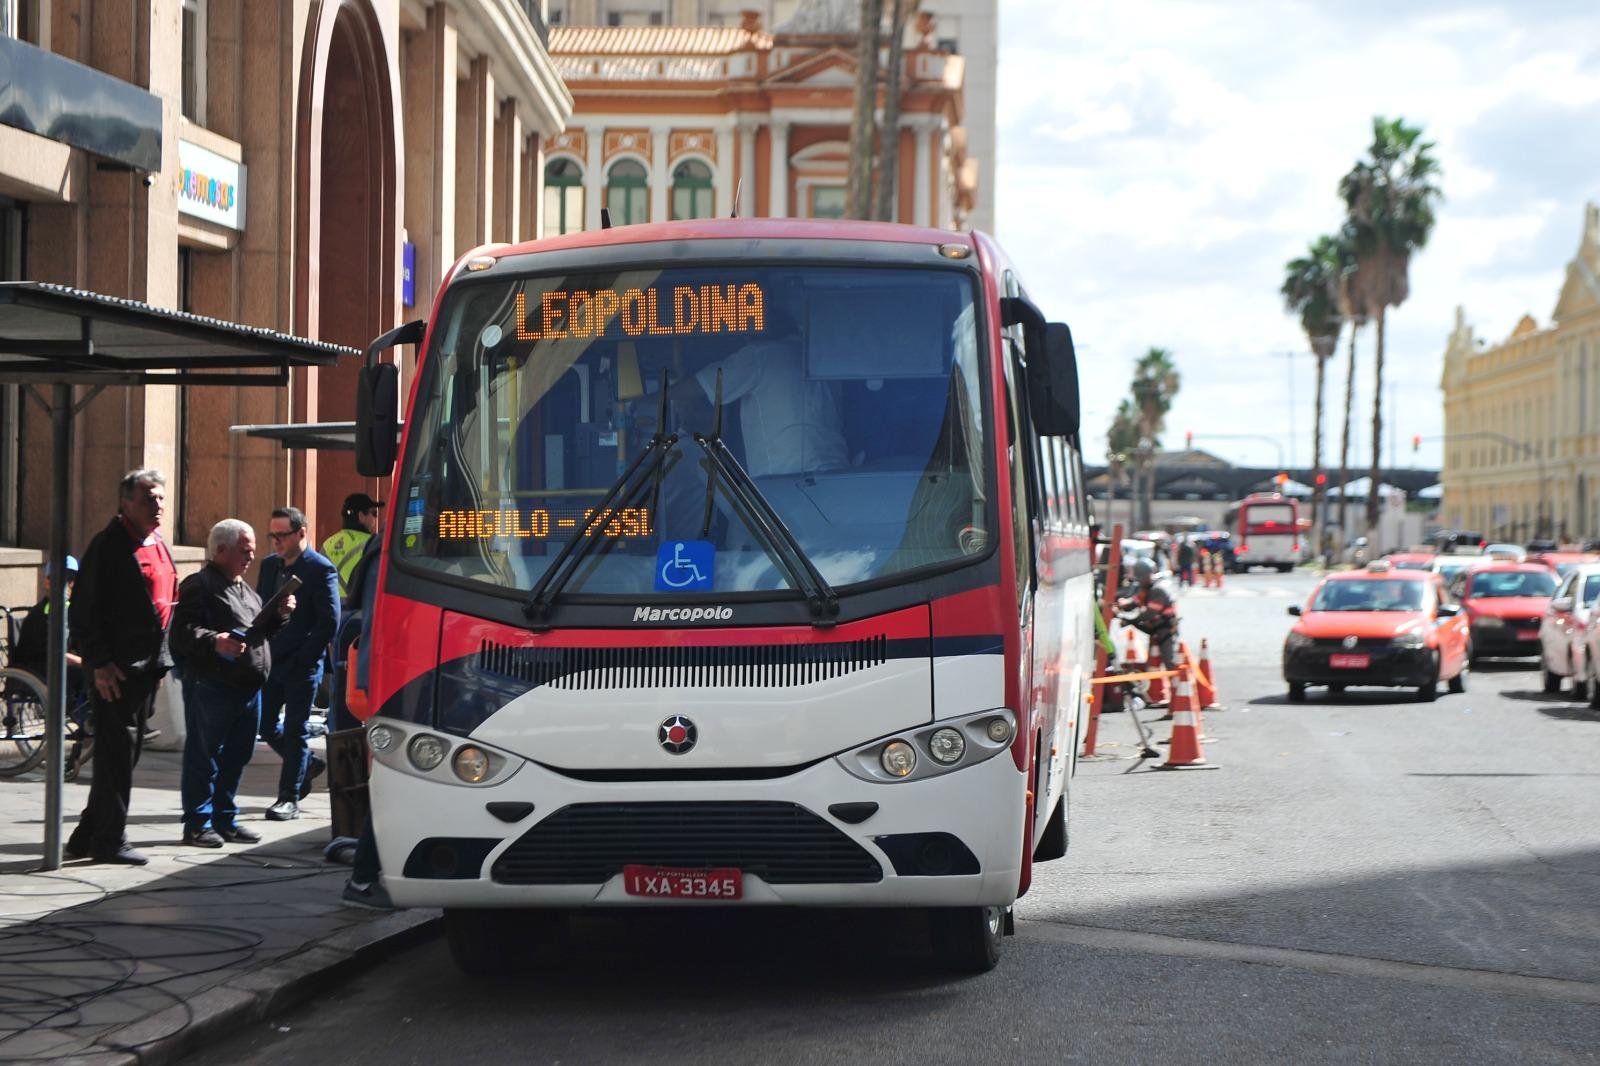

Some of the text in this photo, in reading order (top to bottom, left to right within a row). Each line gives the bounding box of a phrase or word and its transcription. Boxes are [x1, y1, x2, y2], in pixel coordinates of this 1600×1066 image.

[516, 284, 764, 340] LEOPOLDINA
[439, 509, 549, 538] ANGULO
[633, 605, 733, 622] Marcopolo
